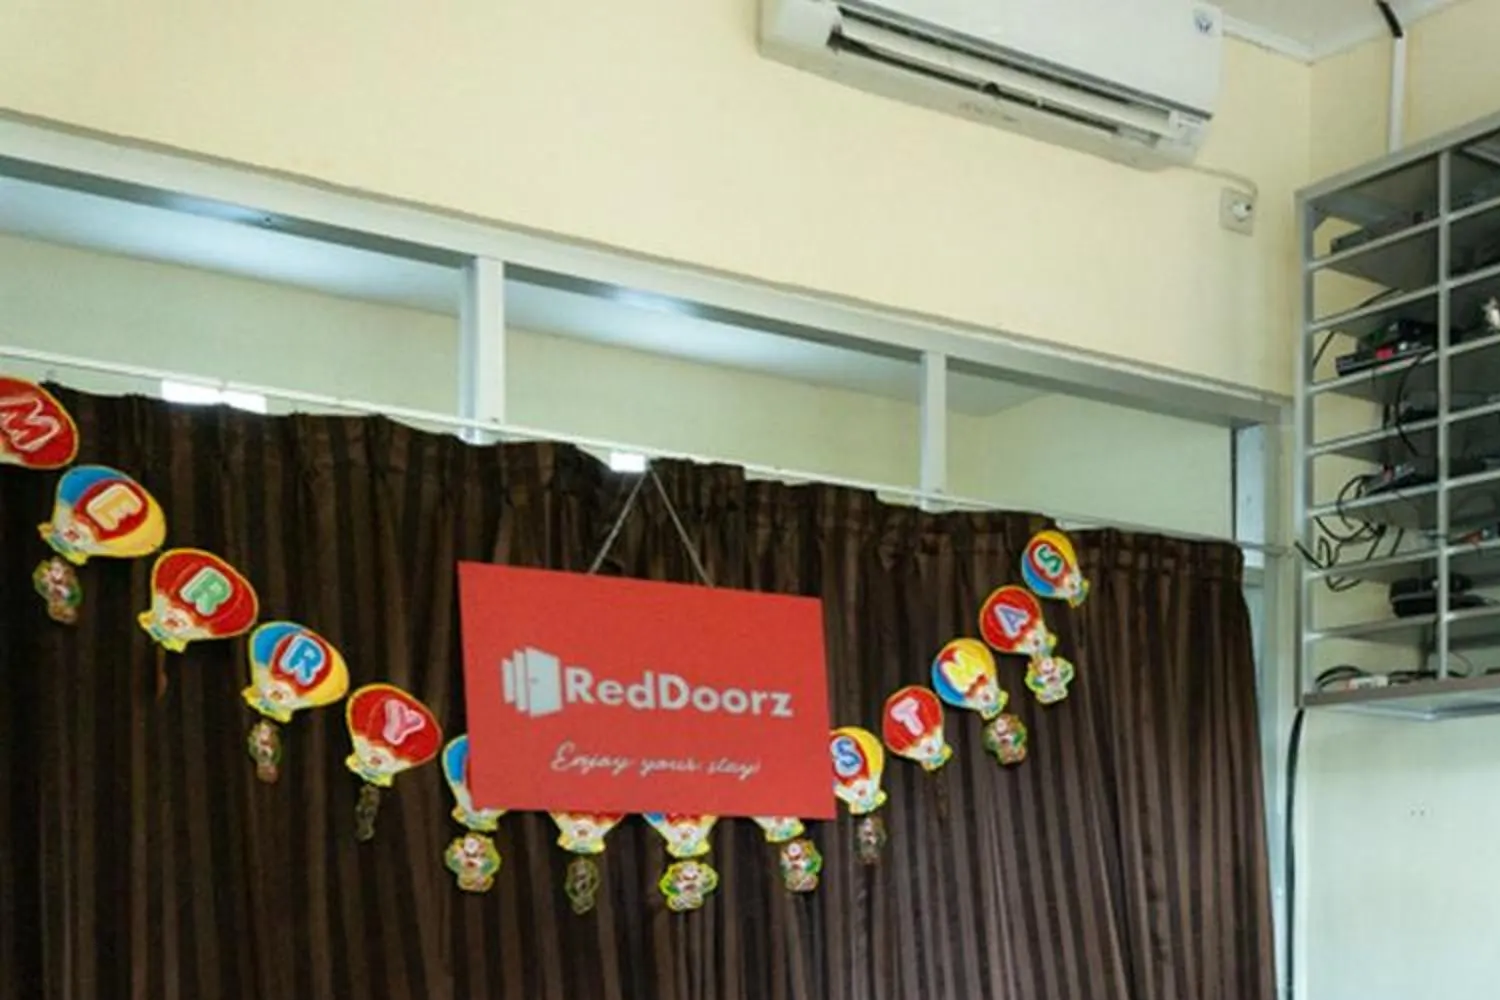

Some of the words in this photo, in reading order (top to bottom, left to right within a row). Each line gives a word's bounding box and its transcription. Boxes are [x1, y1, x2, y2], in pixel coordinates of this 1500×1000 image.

[564, 665, 794, 718] RedDoorz
[550, 740, 630, 776] Enjoy
[640, 757, 700, 777] your
[706, 758, 761, 780] stay
